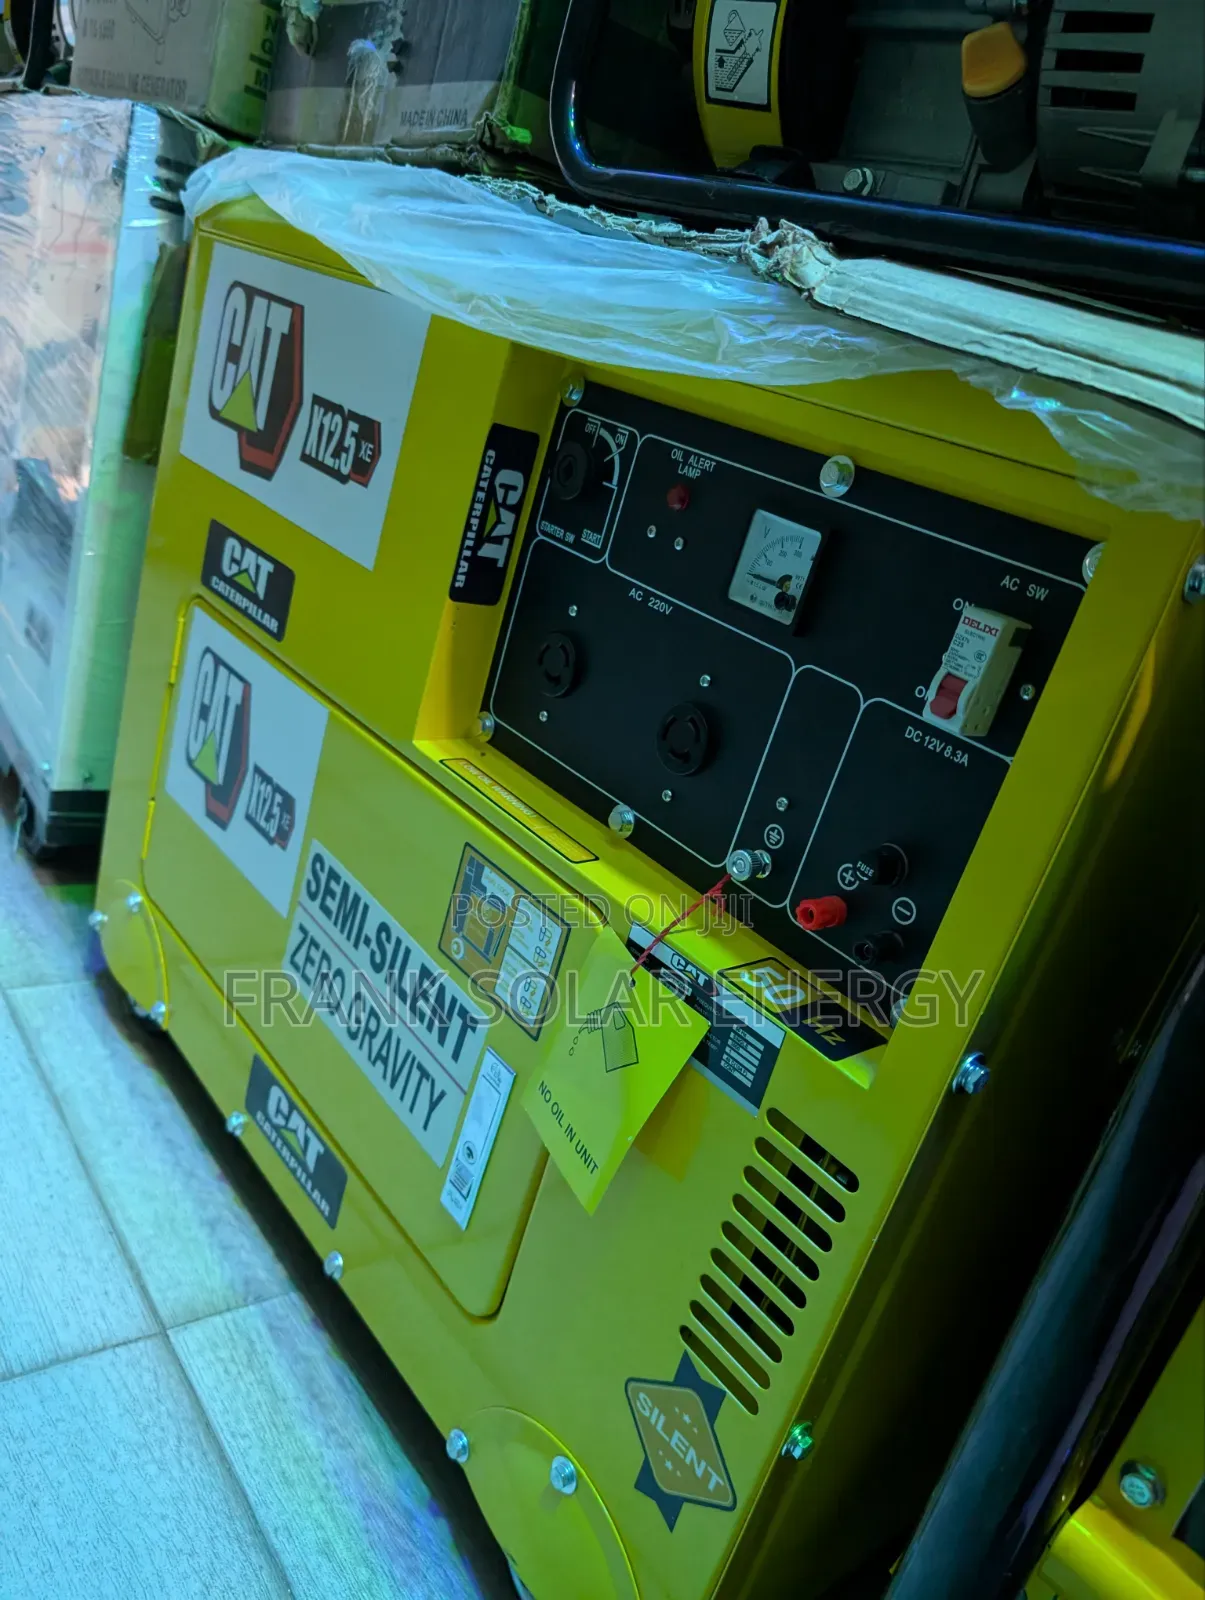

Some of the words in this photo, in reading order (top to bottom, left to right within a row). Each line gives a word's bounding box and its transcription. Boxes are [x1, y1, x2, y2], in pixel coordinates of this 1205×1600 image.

[401, 110, 426, 127] MADE
[437, 107, 468, 129] CHINA
[211, 285, 293, 432] CAT
[305, 403, 360, 476] X12.5
[359, 439, 374, 463] XE
[585, 421, 597, 435] OFF
[615, 433, 626, 445] ON
[670, 447, 684, 462] OIL
[687, 455, 717, 473] ALERT
[677, 463, 702, 479] LAMP
[454, 449, 496, 588] CATERPILLAR
[477, 469, 524, 567] CAT
[540, 520, 565, 539] STARTER
[564, 532, 576, 545] SW
[581, 529, 602, 545] START
[221, 537, 275, 601] CAT
[1000, 575, 1020, 591] AC
[1026, 584, 1049, 601] SW
[209, 575, 280, 634] CATERPILLAR
[628, 587, 644, 602] AC
[647, 596, 673, 616] 220V
[961, 616, 1000, 637] DELIXI
[188, 652, 245, 786] CAT
[904, 725, 923, 743] DC
[923, 735, 945, 753] 12V
[943, 745, 969, 767] 8.3A
[248, 770, 283, 842] X12.5
[856, 860, 875, 878] FUSE
[305, 852, 480, 1065] SEMI-SILENT
[671, 953, 709, 987] CAT
[740, 966, 806, 1005] 50
[288, 921, 346, 1017] ZERO
[347, 990, 448, 1133] GRAVITY
[267, 1084, 325, 1174] CAT
[538, 1080, 552, 1103] NO
[551, 1101, 565, 1129] OIL
[564, 1123, 577, 1143] IN
[574, 1139, 599, 1175] UNIT
[255, 1110, 331, 1218] CATERPILLAR
[636, 1391, 725, 1493] SILENT
